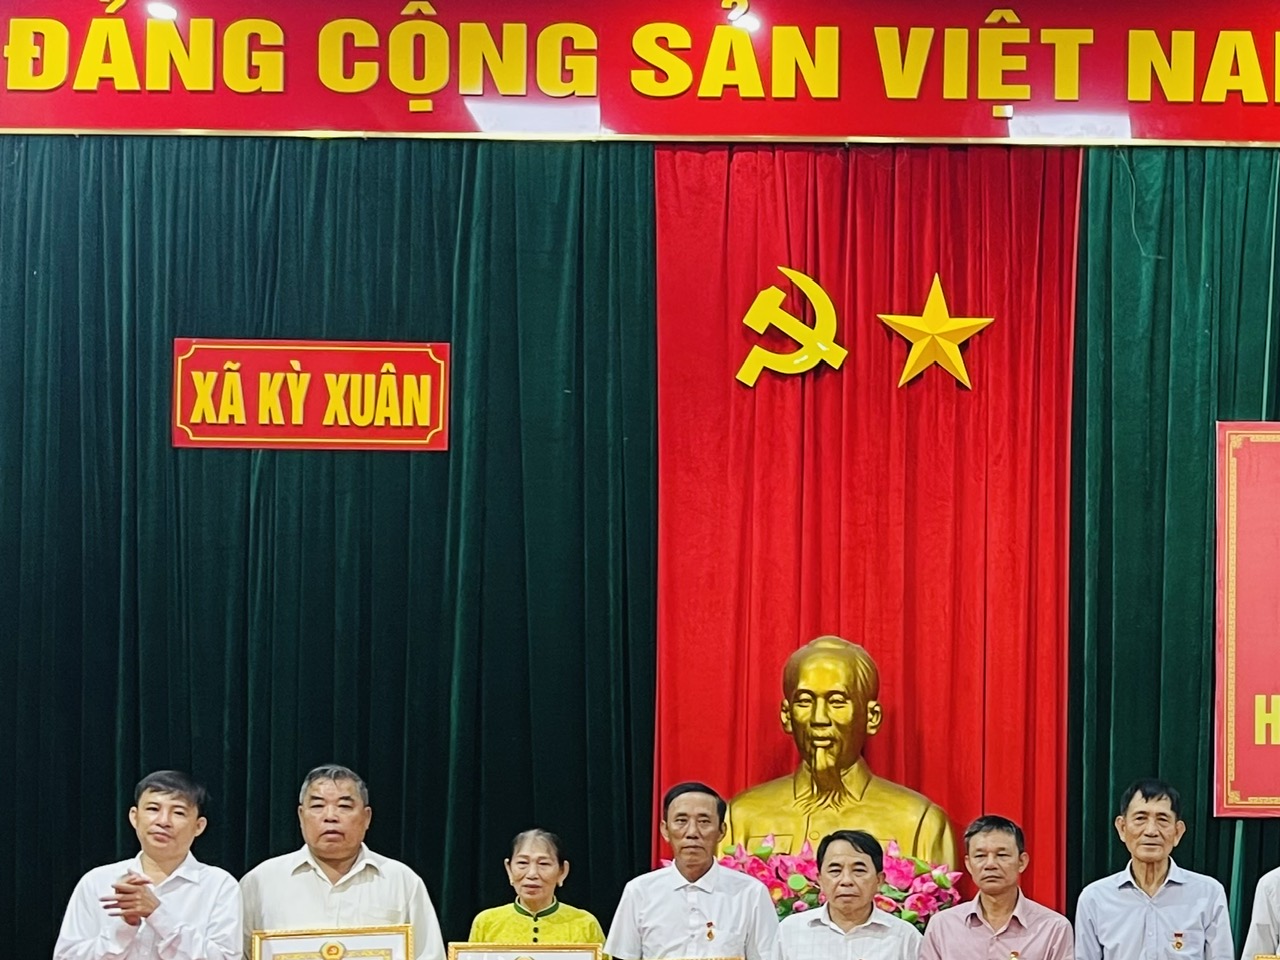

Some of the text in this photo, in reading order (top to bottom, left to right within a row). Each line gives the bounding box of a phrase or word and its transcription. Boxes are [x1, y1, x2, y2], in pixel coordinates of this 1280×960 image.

[317, 0, 600, 112] CỘNG
[630, 0, 841, 99] SẢN
[873, 9, 1094, 118] VIỆT
[189, 360, 432, 428] XÃ KỲ XUÂN
